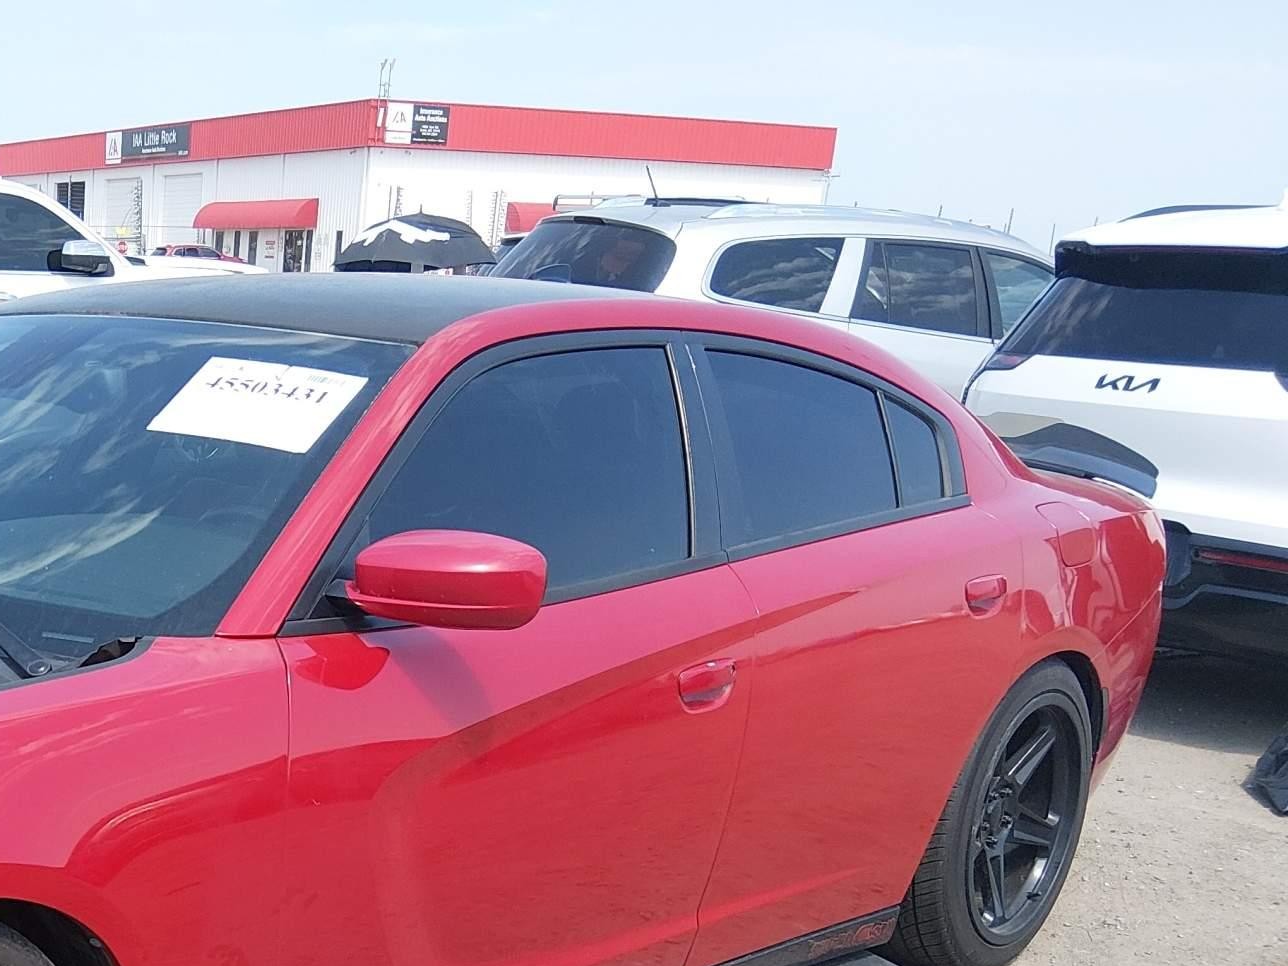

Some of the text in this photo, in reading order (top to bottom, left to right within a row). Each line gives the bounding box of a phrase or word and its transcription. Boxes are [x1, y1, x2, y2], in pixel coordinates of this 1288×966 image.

[144, 131, 160, 146] Little
[161, 129, 177, 144] Rock
[206, 376, 329, 404] 45503431
[1095, 374, 1161, 393] KIA
